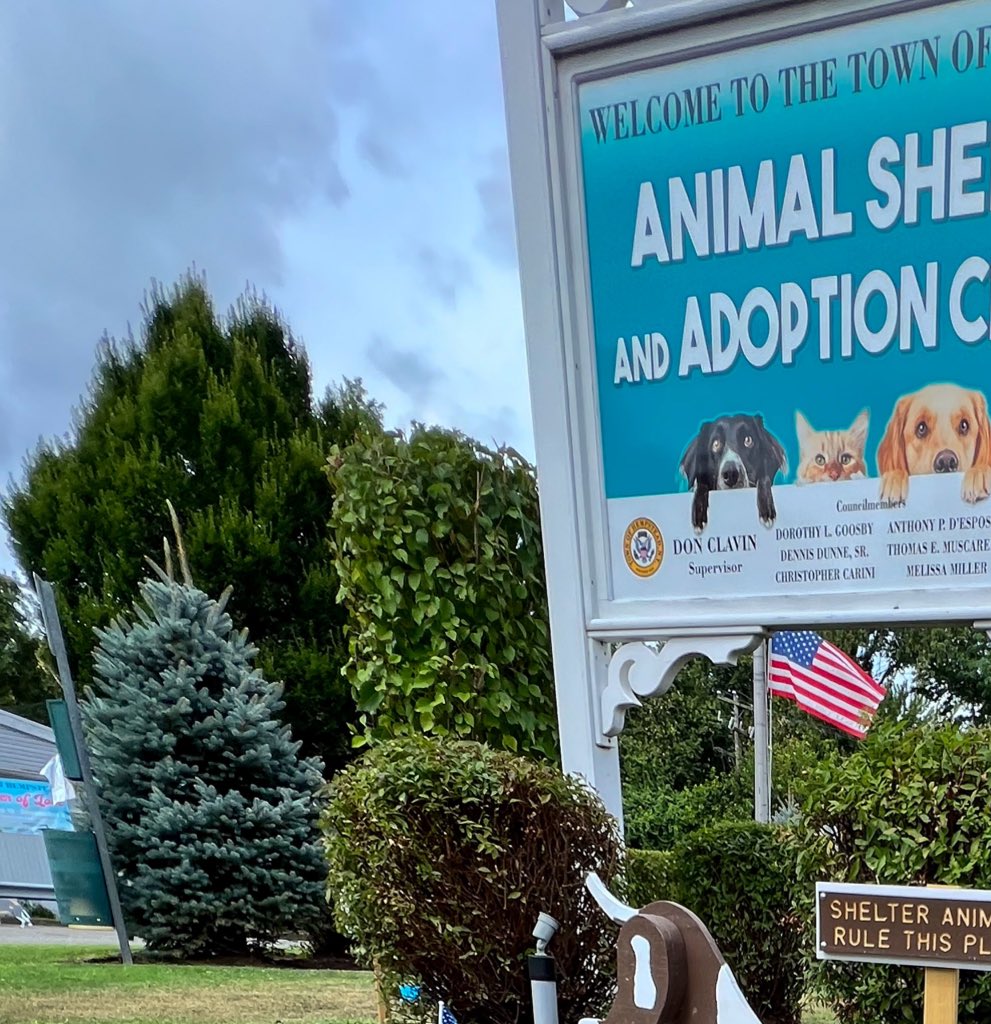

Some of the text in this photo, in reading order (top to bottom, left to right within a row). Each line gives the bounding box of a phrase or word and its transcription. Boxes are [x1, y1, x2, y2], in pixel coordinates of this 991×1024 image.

[589, 83, 722, 144] WELCOME
[730, 73, 769, 117] TO
[778, 58, 838, 108] THE
[847, 36, 941, 93] TOWN
[631, 147, 853, 268] ANIMAL
[613, 331, 670, 384] AND
[678, 261, 939, 378] ADOPTION
[836, 498, 906, 513] Councilmembers
[775, 521, 874, 540] DOROTHY L. GOOSBY
[887, 518, 936, 534] ANTHONY
[938, 518, 945, 531] P.
[673, 534, 757, 556] DON CLAVIN
[780, 545, 869, 562] DENNIS DUNNE, SR.
[887, 541, 928, 556] THOMAS
[930, 541, 940, 554] E.
[688, 560, 743, 577] Supervisor
[775, 566, 875, 583] CHRISTOPHER CARINI
[906, 561, 988, 577] MELISSA MILLER
[830, 899, 930, 925] SHELTER
[834, 926, 891, 950] RULE
[903, 930, 952, 953] THIS
